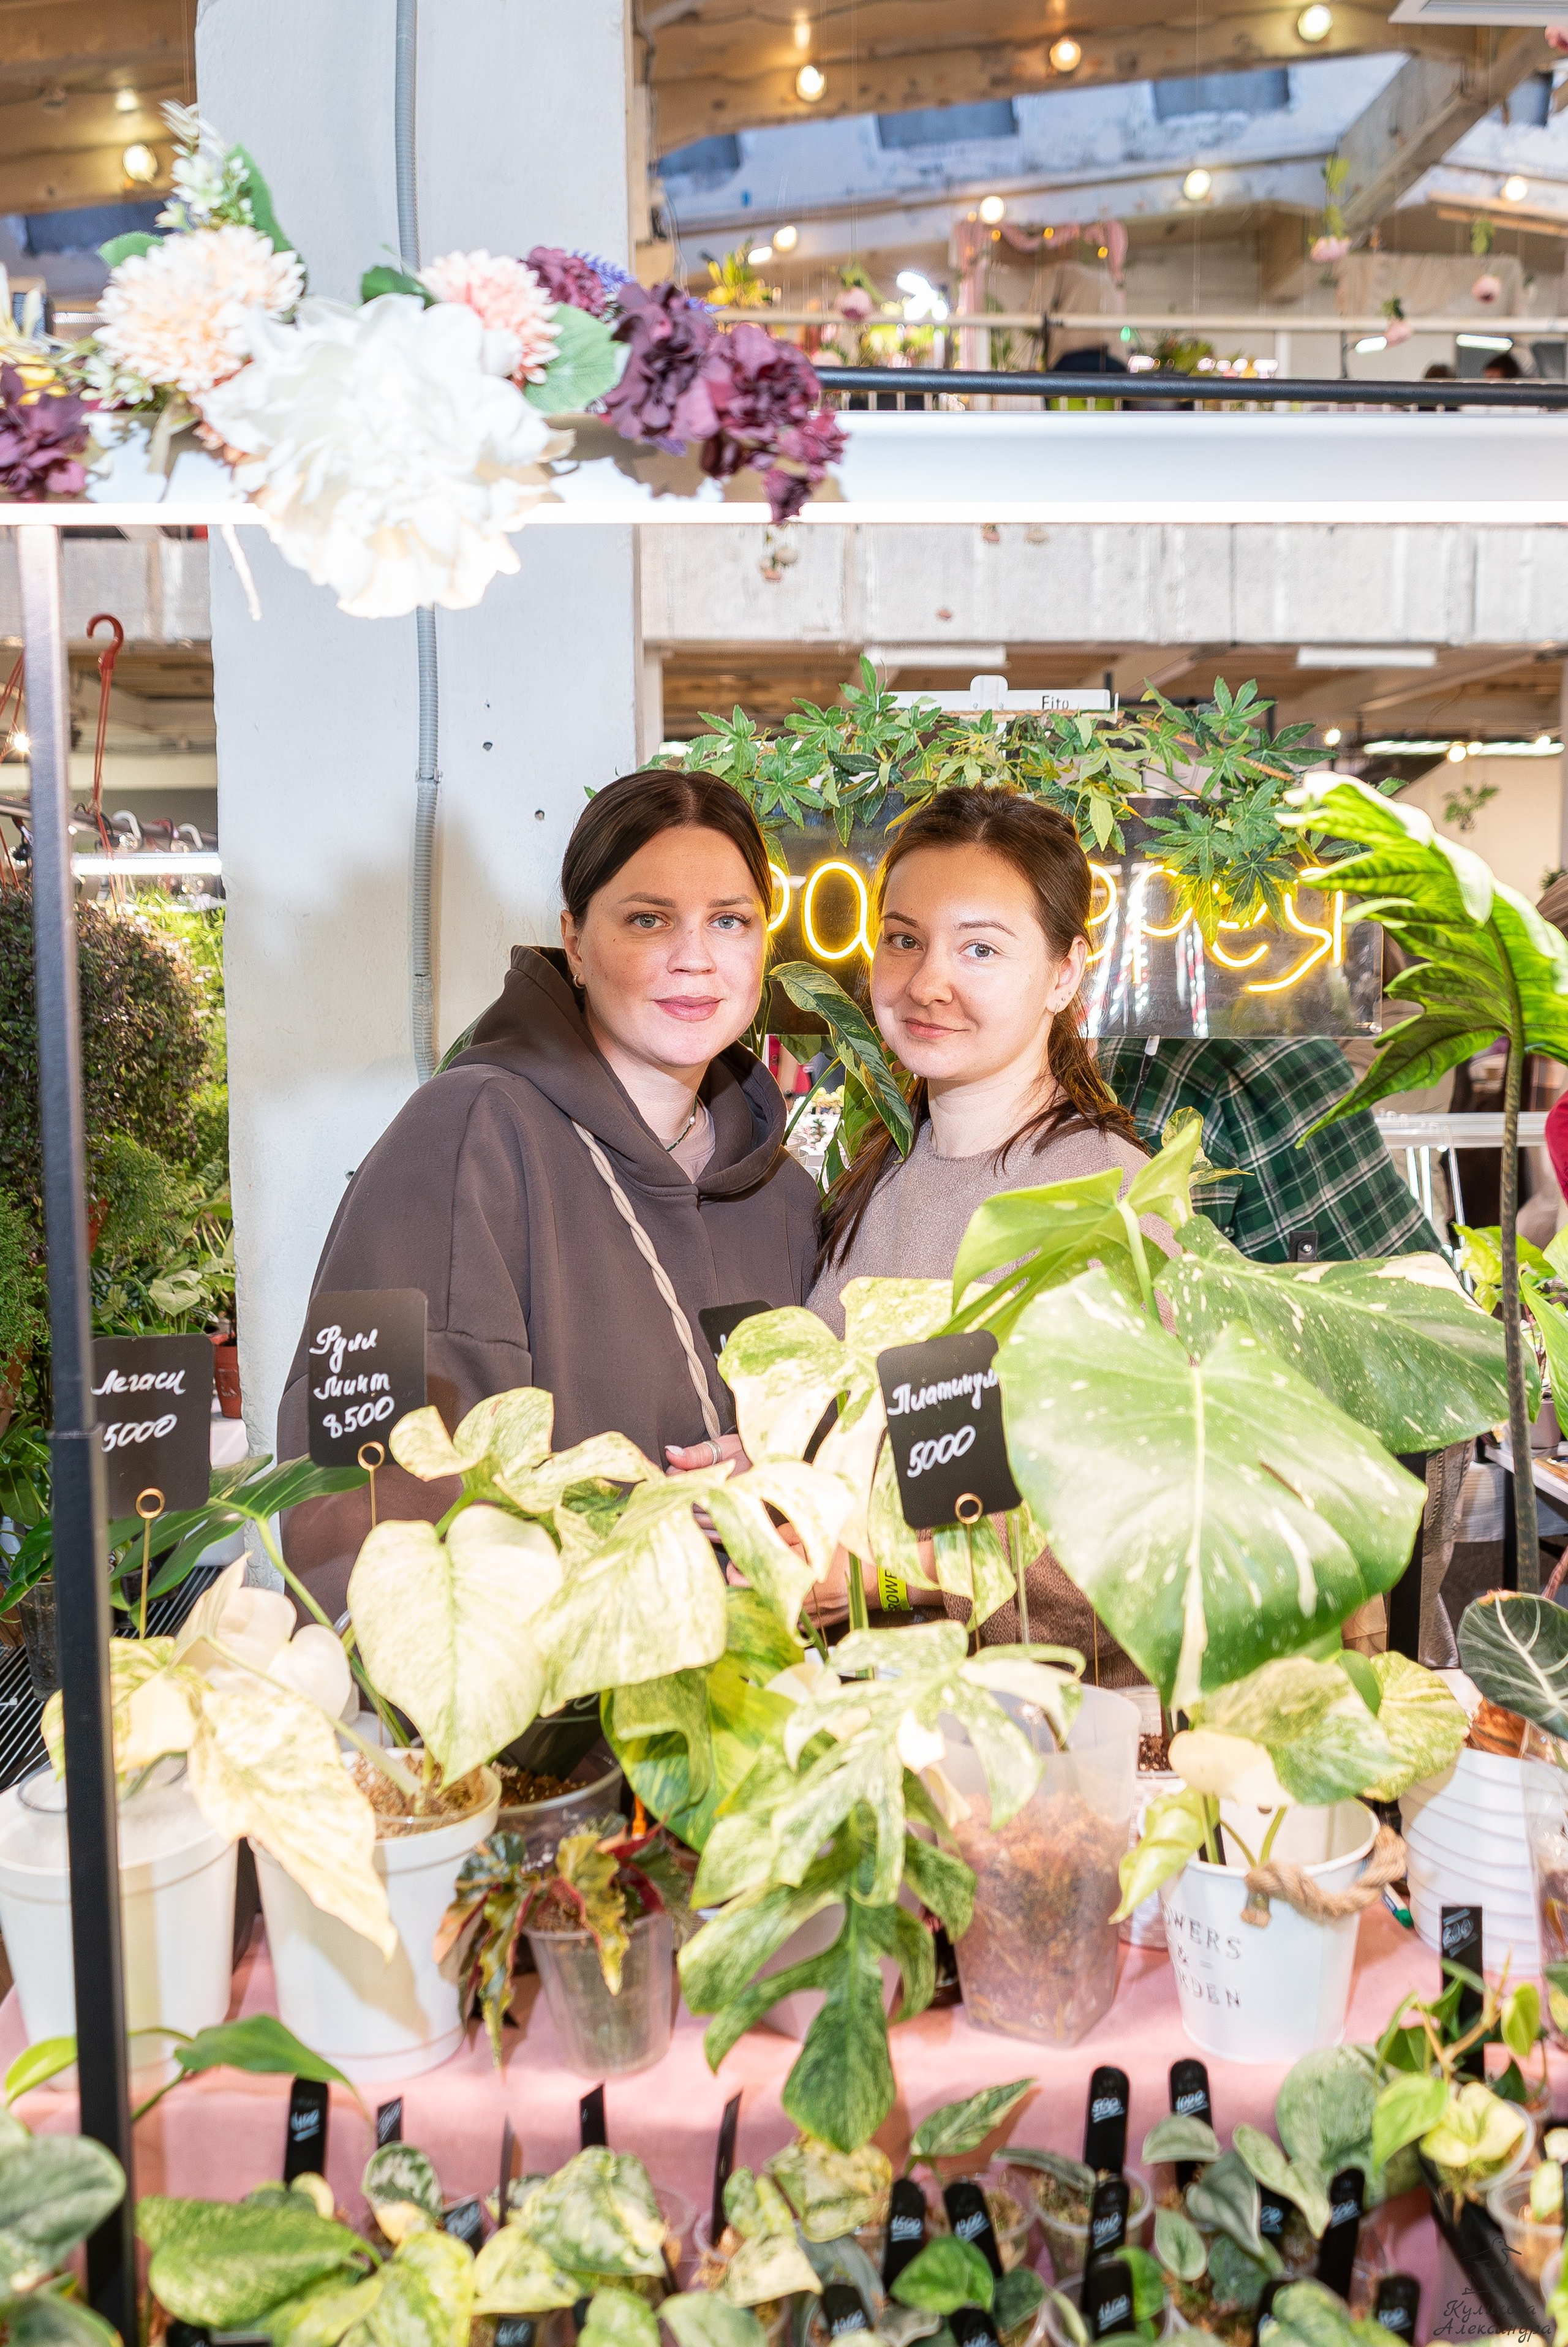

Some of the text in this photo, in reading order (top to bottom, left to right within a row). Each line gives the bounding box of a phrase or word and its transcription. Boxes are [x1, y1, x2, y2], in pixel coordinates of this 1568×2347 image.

[101, 1413, 178, 1453] 5000
[322, 1395, 395, 1439] 8500
[907, 1424, 977, 1479] 5000
